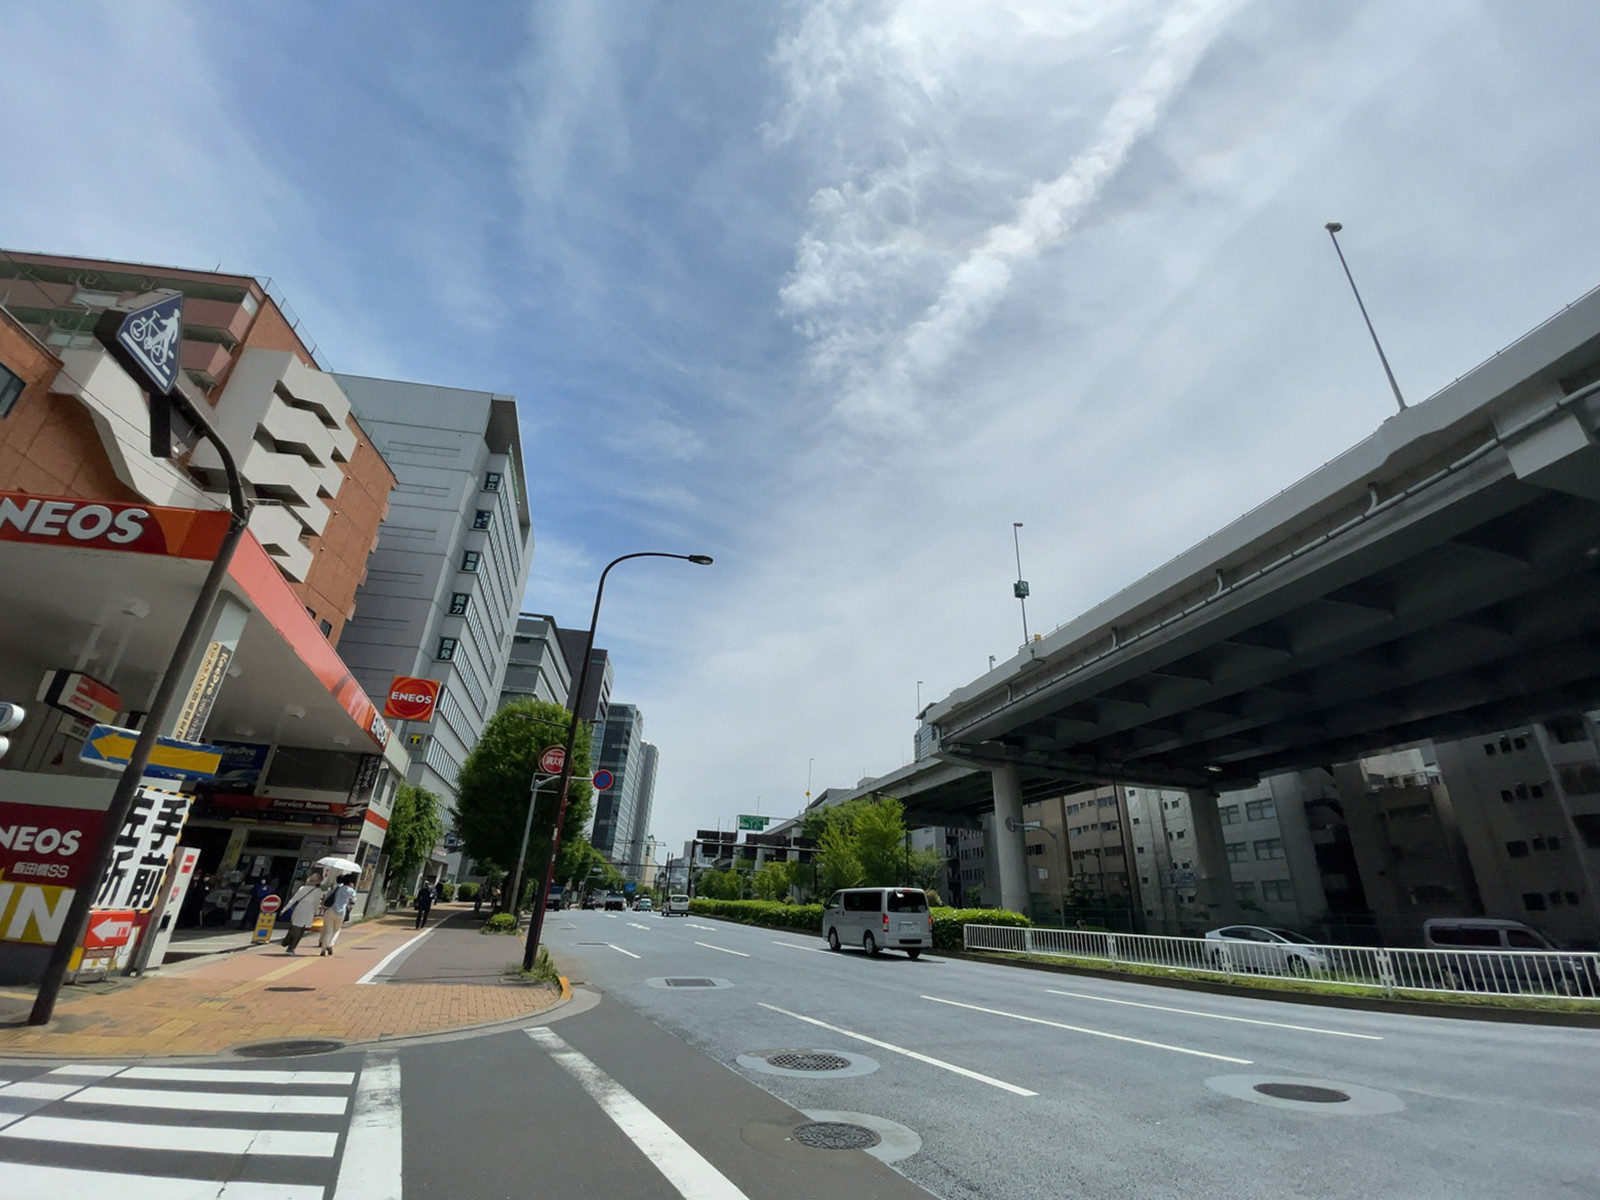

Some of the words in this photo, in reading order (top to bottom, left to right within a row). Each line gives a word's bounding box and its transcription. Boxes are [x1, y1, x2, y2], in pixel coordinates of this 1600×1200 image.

[0, 497, 149, 544] NEOS
[391, 691, 432, 705] ENEOS
[0, 825, 82, 856] NEOS
[125, 799, 188, 908] 手前
